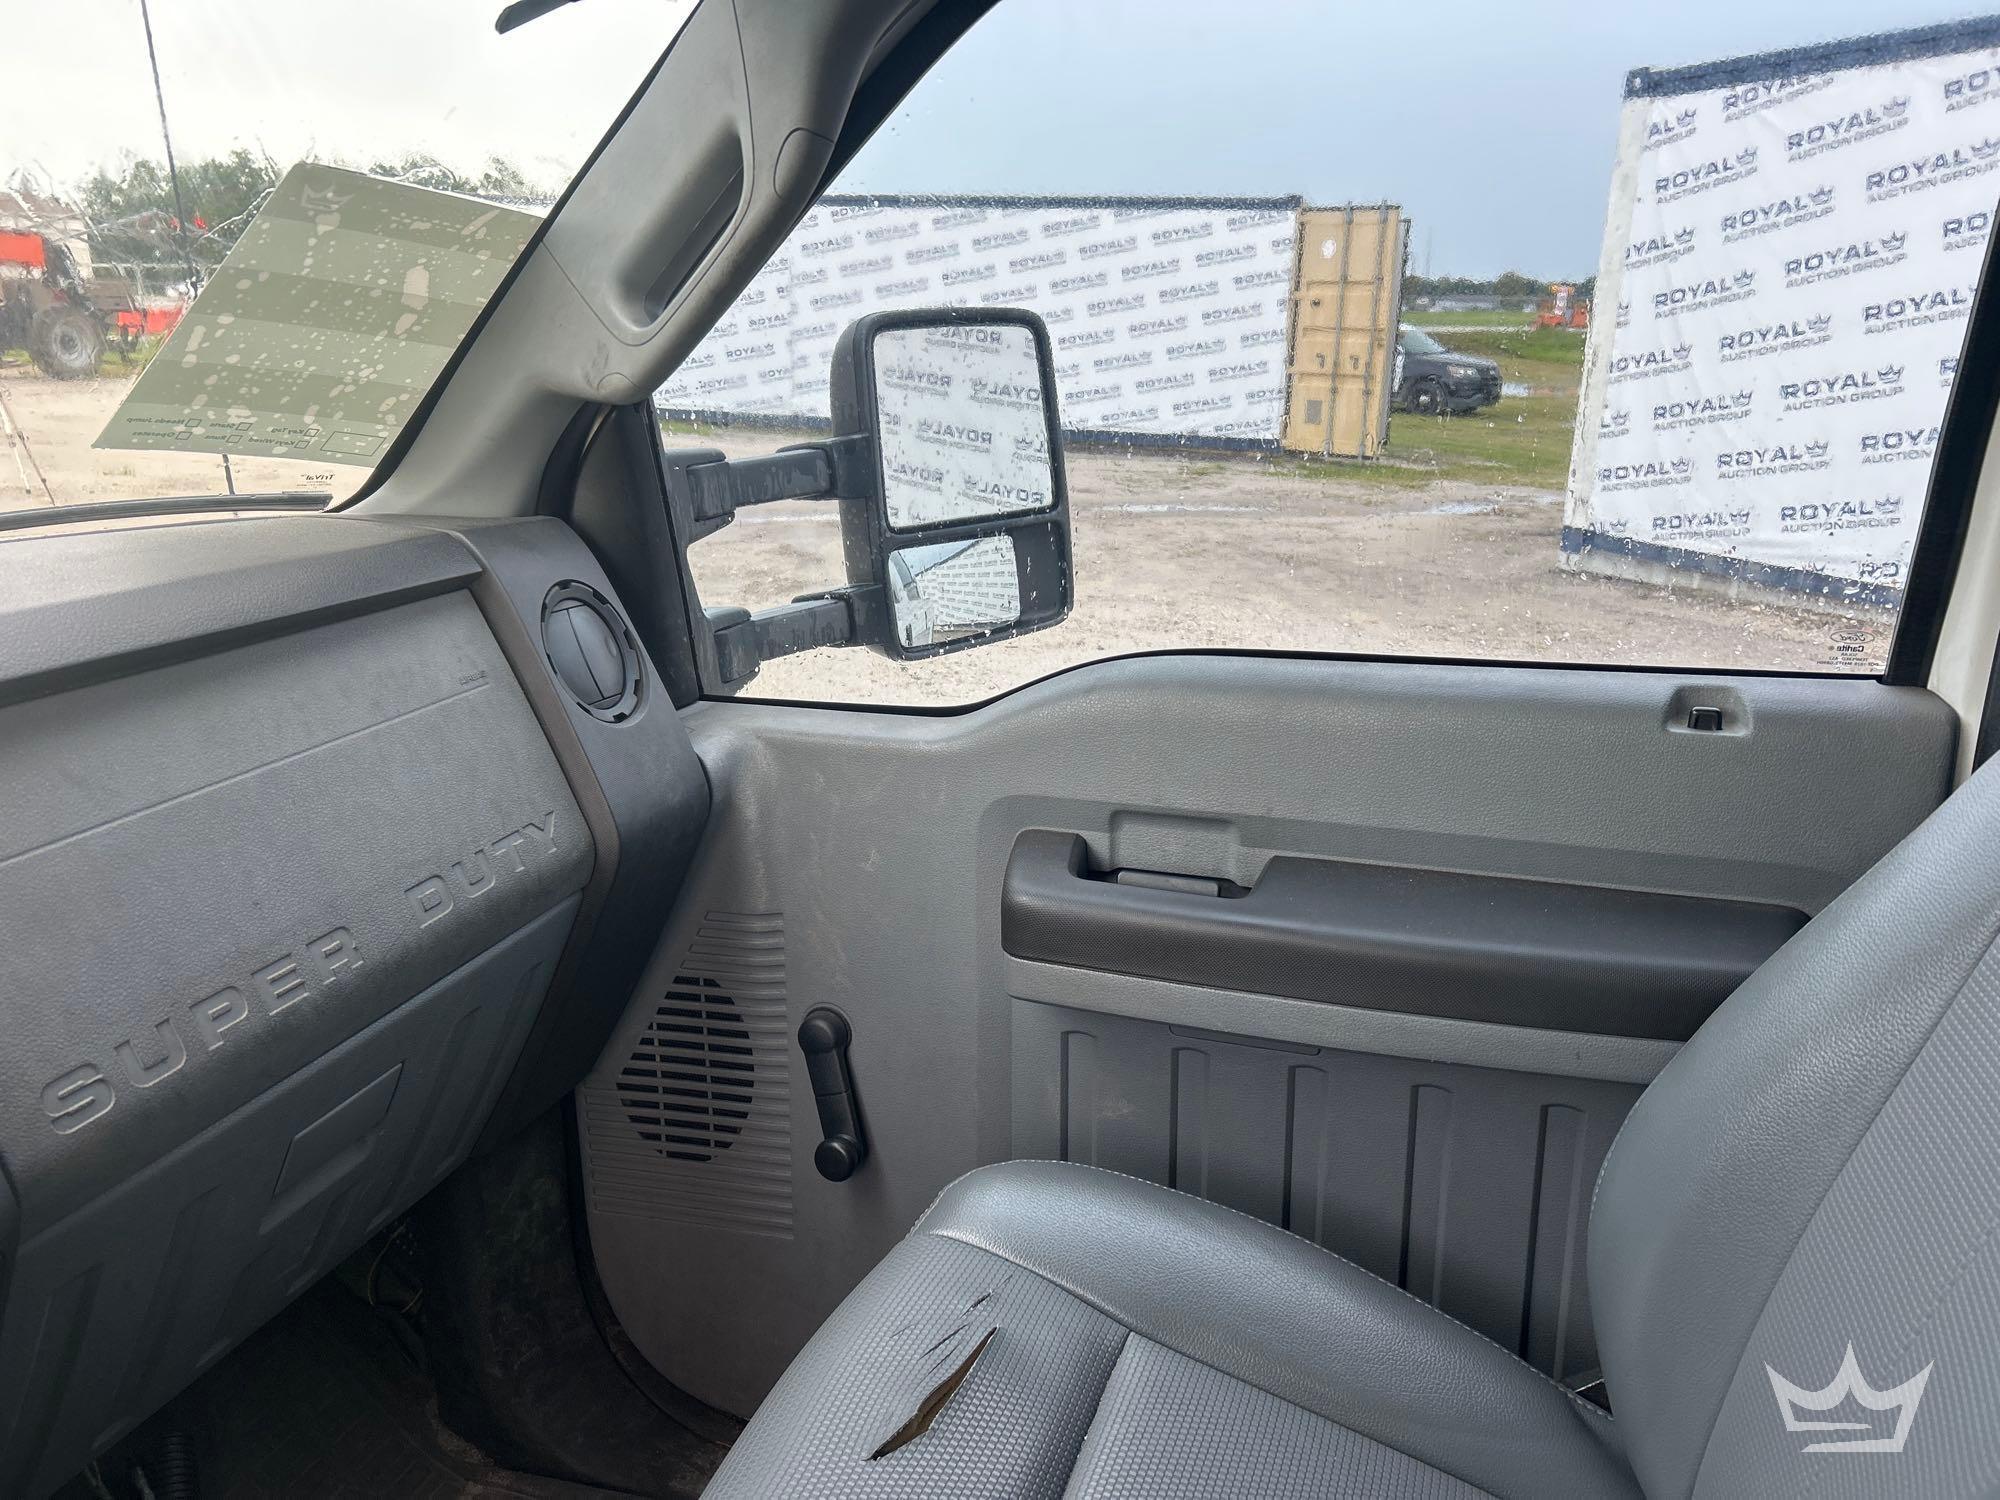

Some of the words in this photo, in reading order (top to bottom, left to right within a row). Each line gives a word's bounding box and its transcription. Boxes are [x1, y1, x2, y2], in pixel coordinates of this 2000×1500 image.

[1787, 108, 1880, 151] ROYAL
[1788, 137, 1851, 162] AUCTION
[1854, 117, 1909, 142] GROUP
[1656, 157, 1734, 193] ROYAL
[1866, 149, 1968, 191] ROYAL
[1656, 182, 1710, 205] AUCTION
[1713, 166, 1758, 188] GROUP
[1867, 177, 1938, 204] AUCTION
[1721, 196, 1808, 231] ROYAL
[1723, 221, 1780, 244] AUCTION
[1784, 206, 1834, 227] GROUP
[1122, 262, 1166, 276] ROYAL
[1785, 241, 1878, 275] ROYAL
[1786, 266, 1850, 288] AUCTION
[1852, 252, 1907, 274] GROUP
[1088, 298, 1131, 311] ROYAL
[1159, 285, 1206, 298] ROYAL
[1654, 278, 1731, 308] ROYAL
[1202, 306, 1247, 320] ROYAL
[1655, 300, 1708, 320] AUCTION
[1864, 288, 1966, 322] ROYAL
[1129, 319, 1174, 332] ROYAL
[1720, 321, 1806, 351] ROYAL
[1865, 314, 1934, 335] AUCTION
[1721, 343, 1778, 363] AUCTION
[1781, 335, 1832, 352] GROUP
[1208, 363, 1255, 377] ROYAL
[1781, 371, 1875, 400] ROYAL
[1653, 395, 1731, 421] ROYAL
[1783, 394, 1847, 412] AUCTION
[1850, 386, 1904, 402] GROUP
[1654, 416, 1706, 432] AUCTION
[1707, 408, 1751, 424] GROUP
[1718, 444, 1803, 468] ROYAL
[1862, 449, 1932, 465] AUCTION
[1599, 461, 1670, 481] ROYAL
[1718, 465, 1777, 480] AUCTION
[1779, 460, 1829, 474] GROUP
[1601, 480, 1649, 493] AUCTION
[1650, 475, 1691, 488] GROUP
[1652, 511, 1728, 531] ROYAL
[1781, 499, 1873, 521] ROYAL
[1781, 520, 1844, 534] AUCTION
[1845, 517, 1900, 530] GROUP
[40, 925, 365, 1134] SUPER
[404, 810, 558, 928] DUTY
